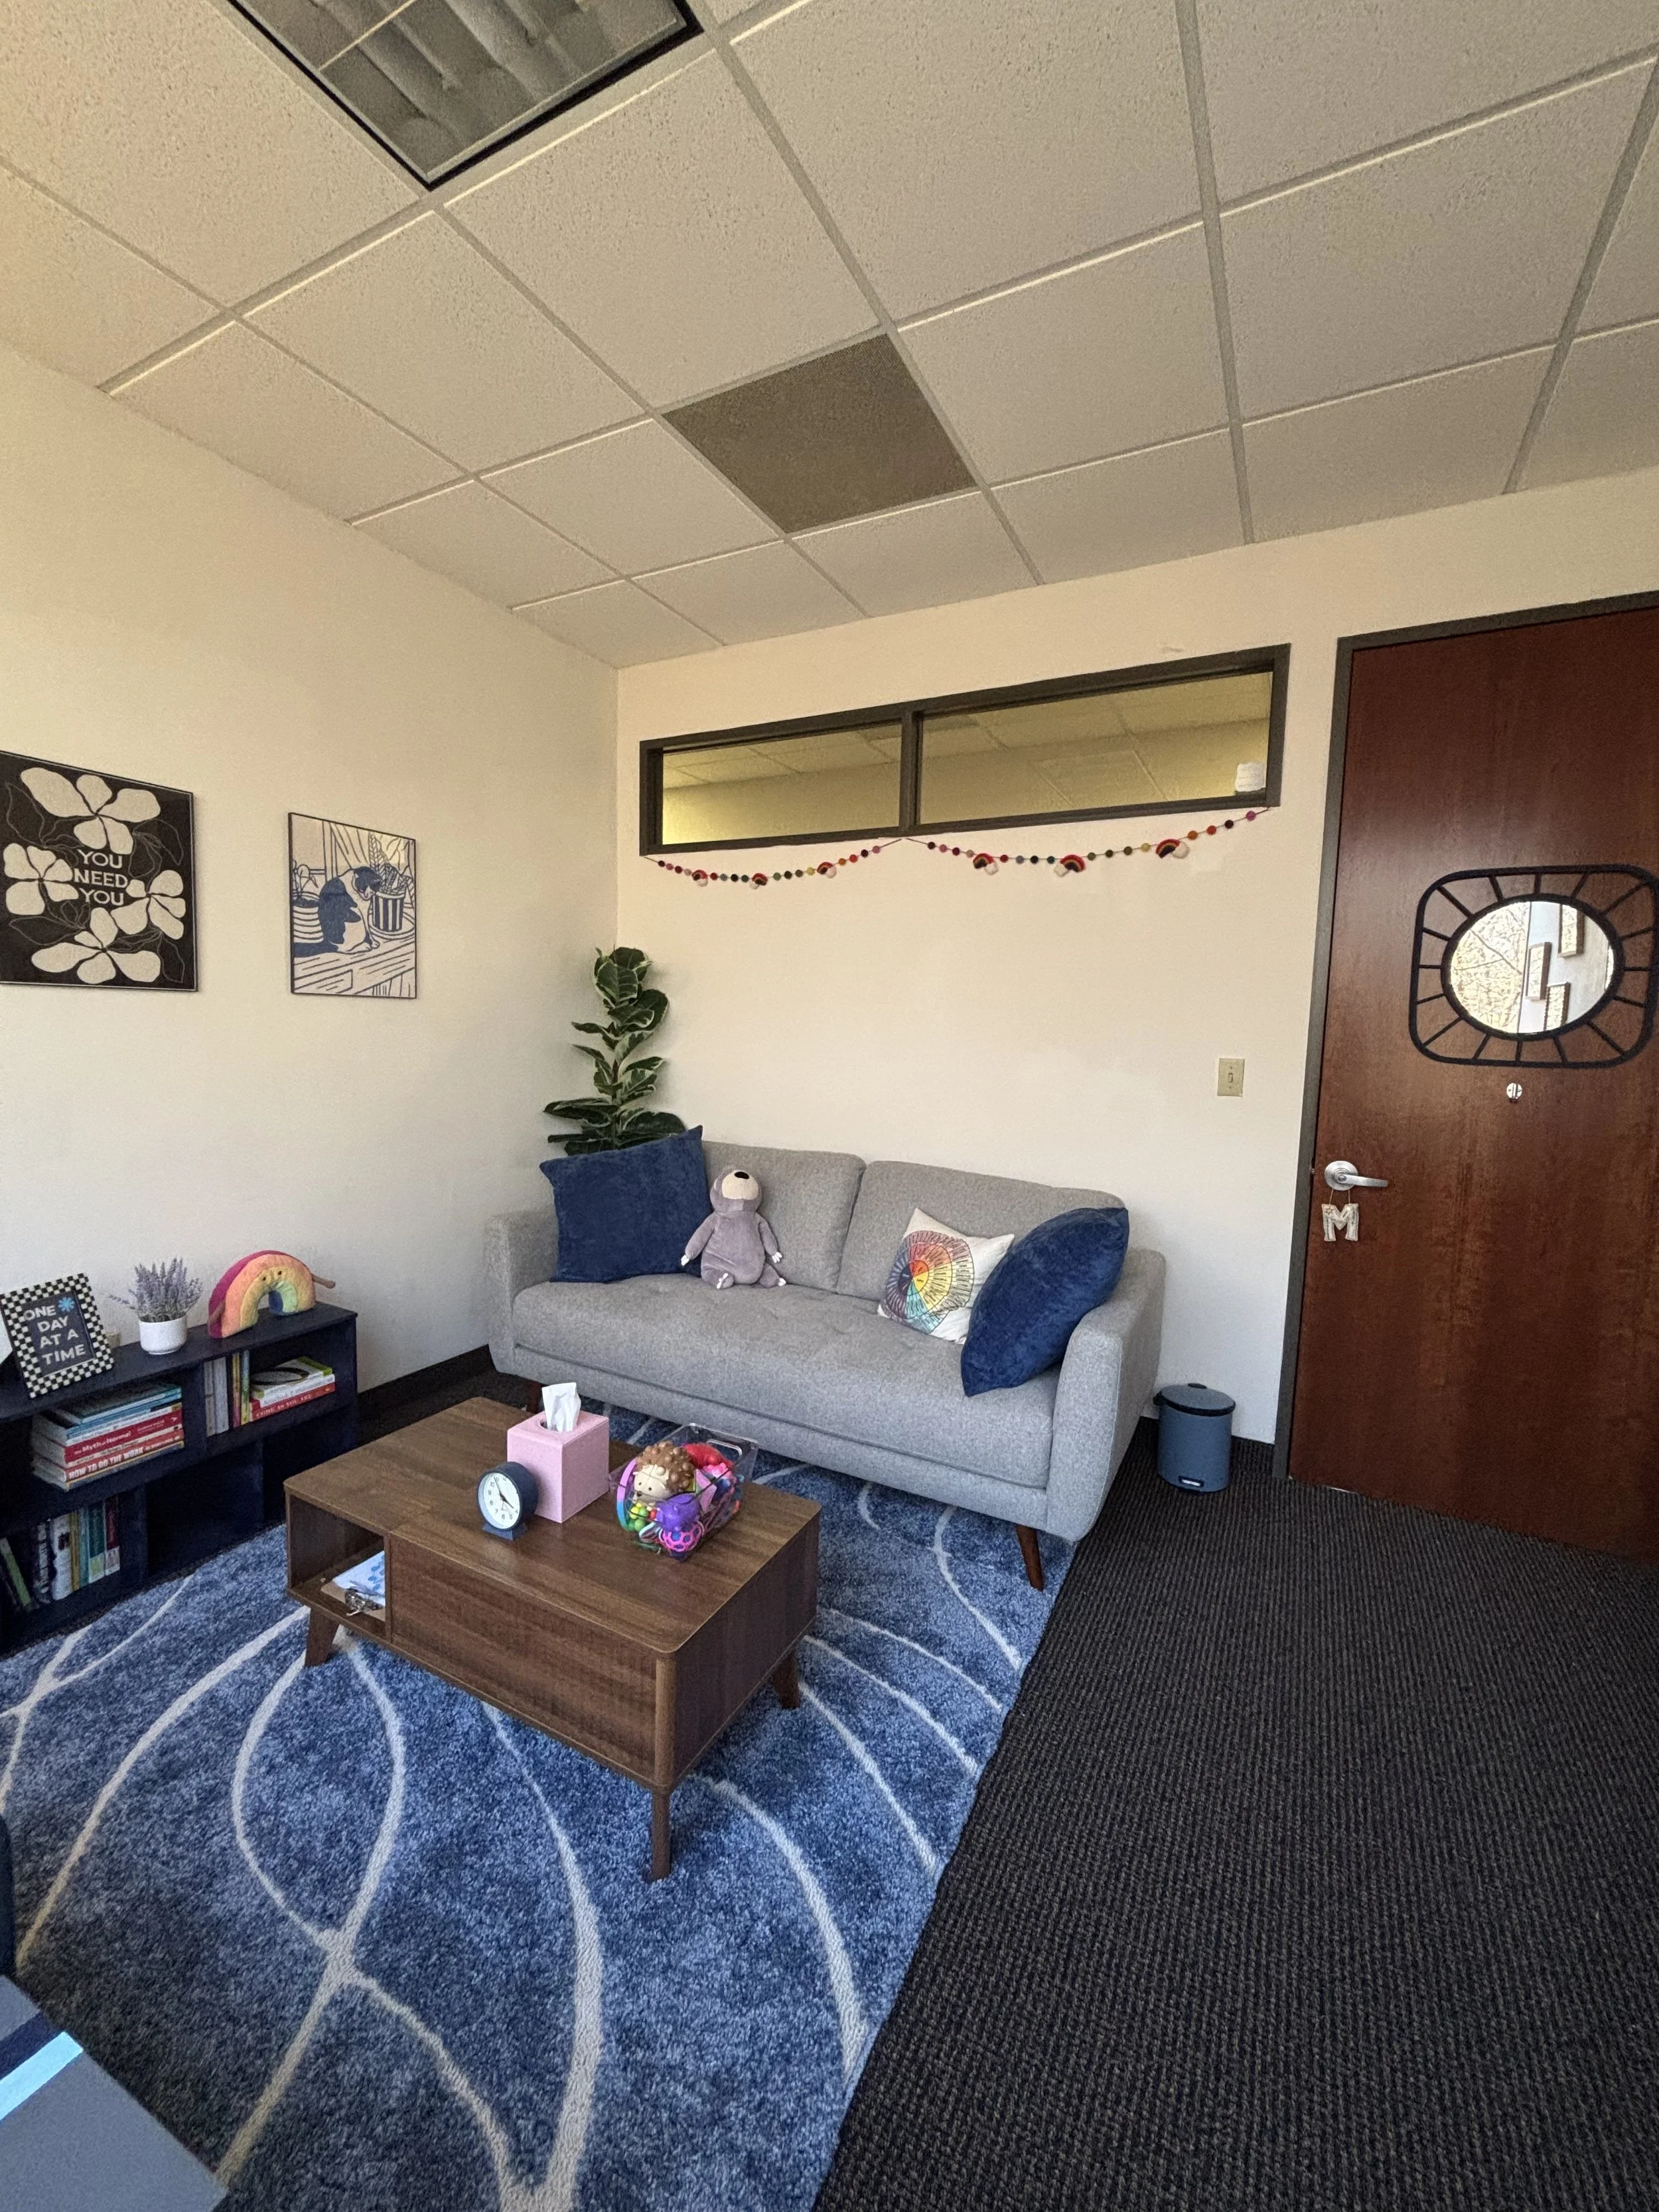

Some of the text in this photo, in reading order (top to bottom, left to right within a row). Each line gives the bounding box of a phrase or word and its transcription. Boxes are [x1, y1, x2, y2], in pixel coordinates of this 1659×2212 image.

[77, 849, 122, 869] YOU
[74, 868, 128, 888] NEED
[79, 887, 124, 906] YOU
[23, 1305, 56, 1321] ONE
[37, 1315, 69, 1333] DAY
[40, 1329, 79, 1349] AT A
[41, 1344, 86, 1365] TIME
[69, 1467, 86, 1479] HOW
[88, 1463, 98, 1472] TO
[109, 1454, 123, 1464] THE
[123, 1446, 143, 1459] WORK
